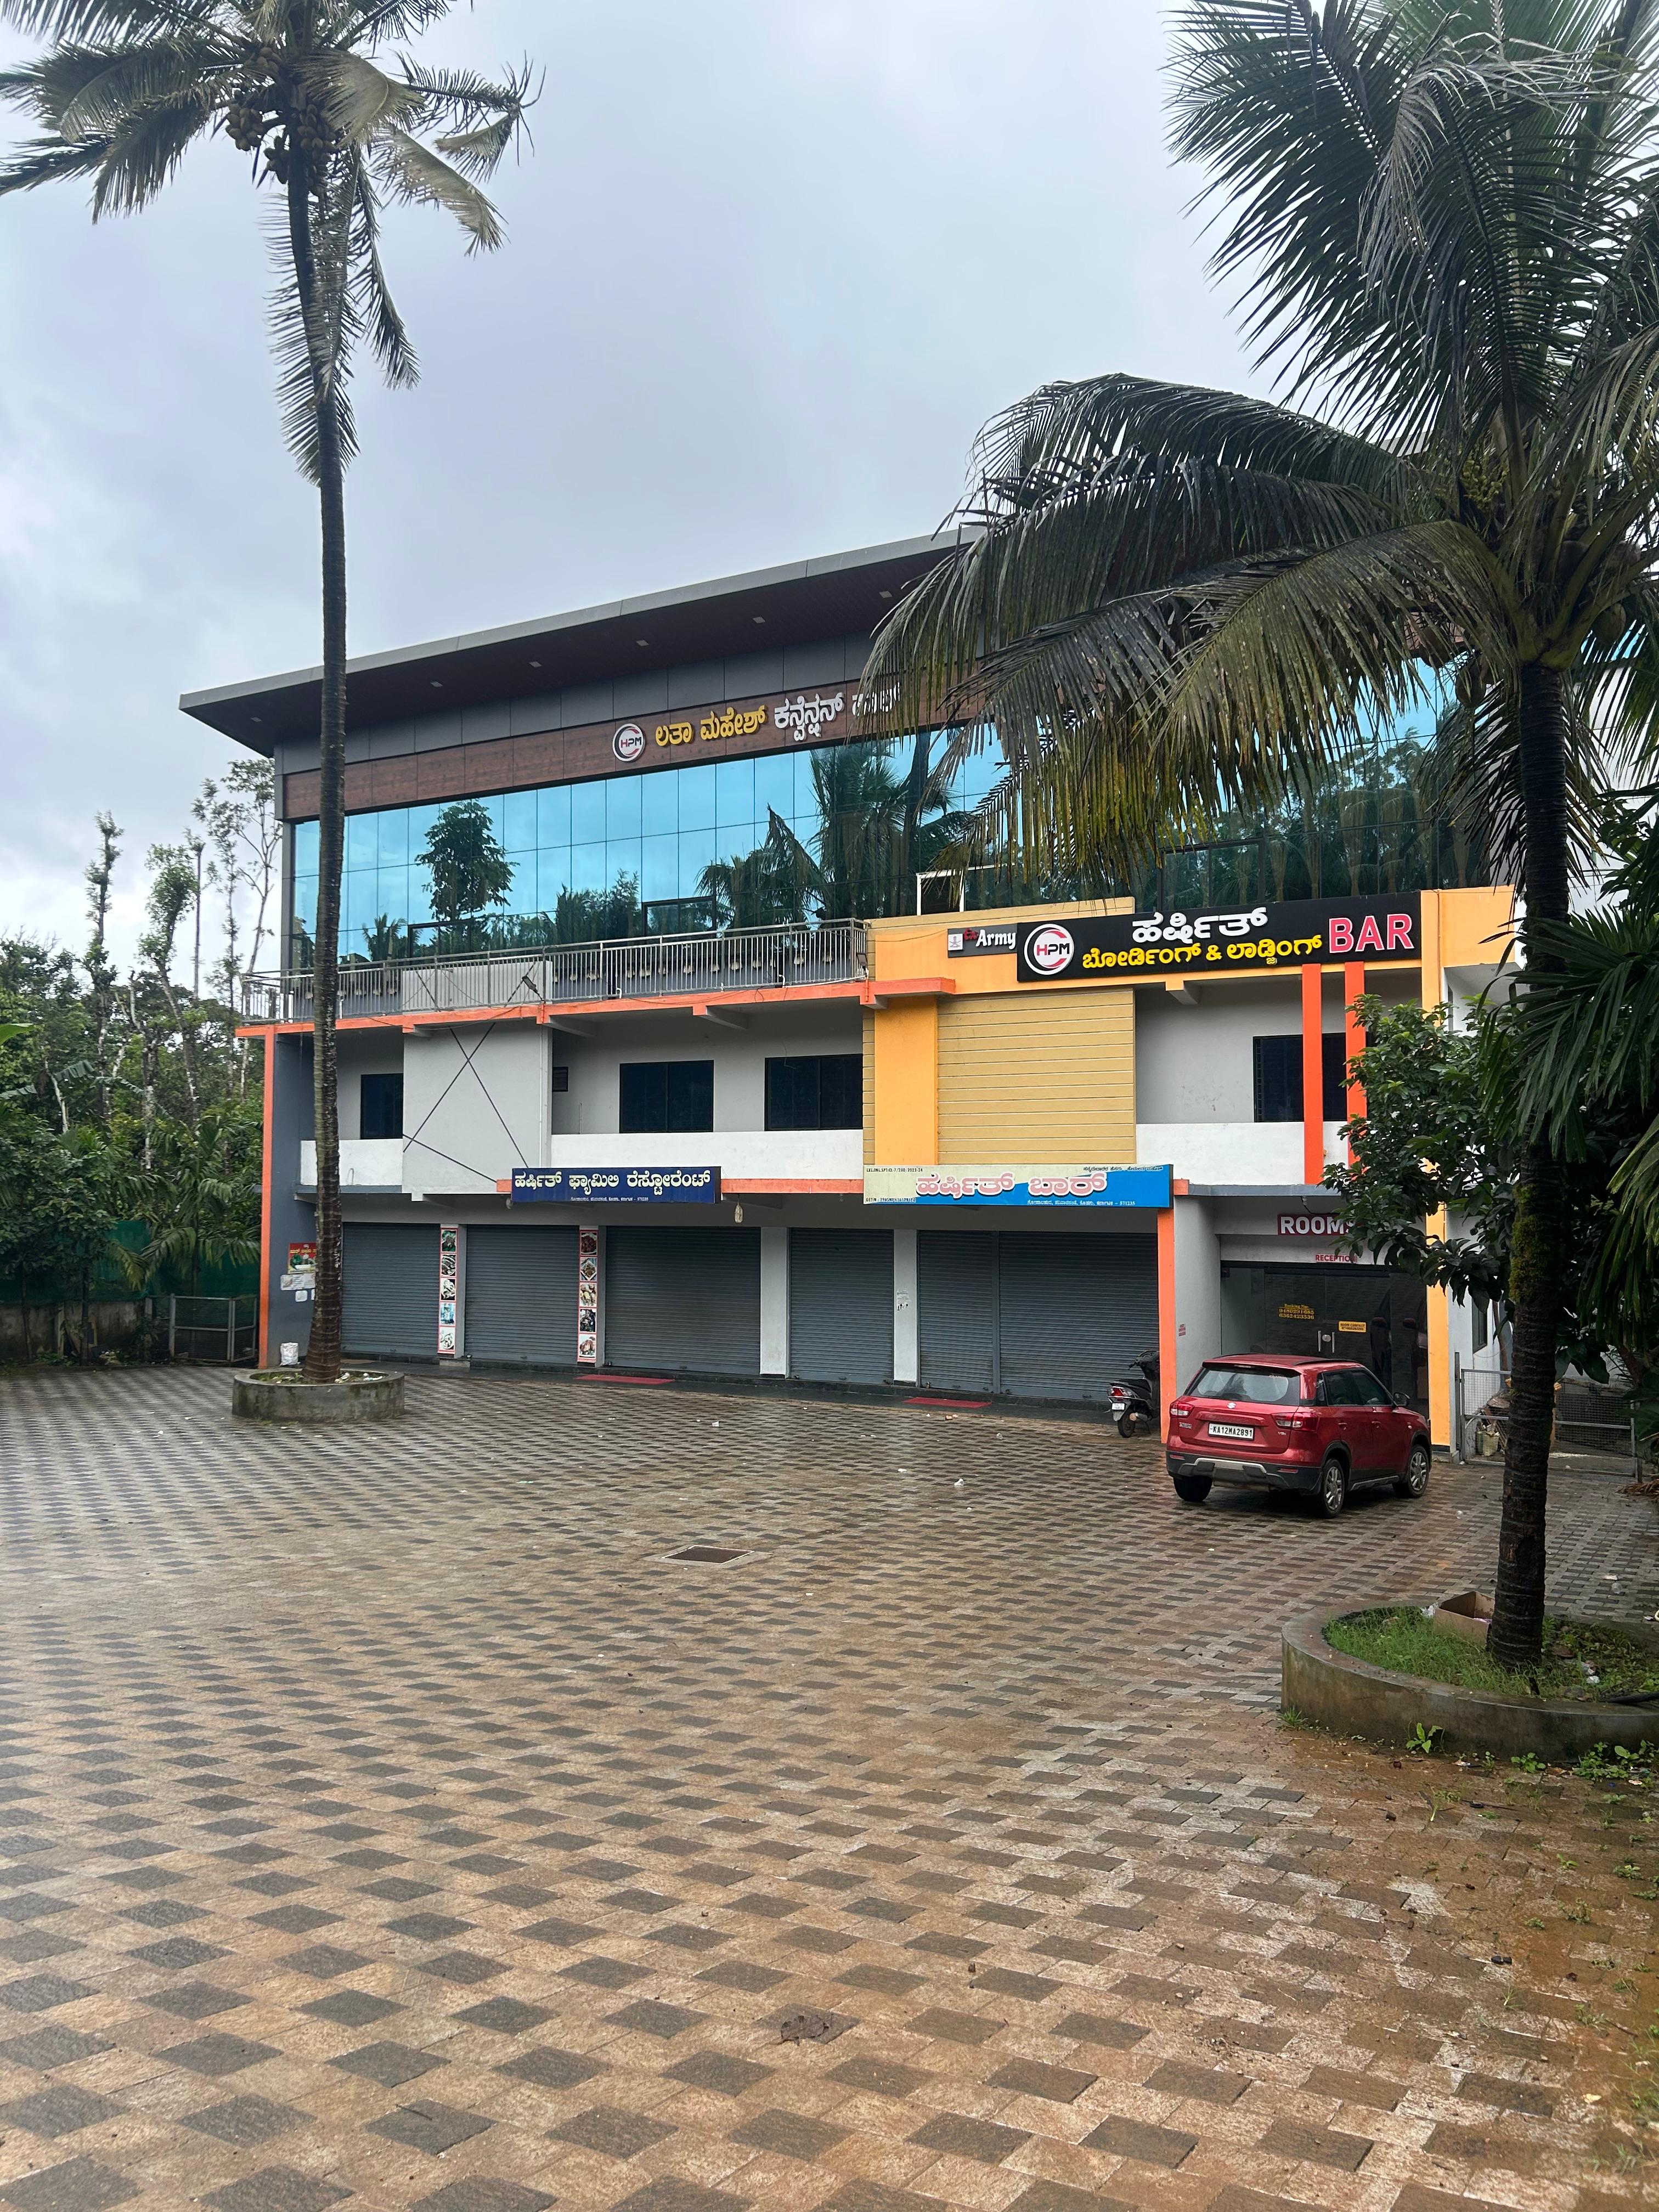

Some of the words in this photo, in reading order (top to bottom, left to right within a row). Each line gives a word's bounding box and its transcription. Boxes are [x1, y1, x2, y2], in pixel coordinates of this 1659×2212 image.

[656, 721, 693, 747] ಲತಾ
[700, 704, 768, 740] ಮಹೇಶ್
[620, 736, 641, 748] HPM
[1132, 907, 1268, 944] ಹರ್ಷಿತ್
[1329, 913, 1415, 953] BAR
[975, 929, 1016, 950] Army
[1036, 943, 1070, 956] HPM
[1082, 943, 1201, 969] ಬೋರ್ಡಿಂಗ್
[1206, 945, 1222, 961] &
[515, 1171, 563, 1190] ಹರ್ಷಿತ್
[569, 1172, 619, 1195] ಫ್ಯಾಮಿಲಿ
[627, 1170, 711, 1195] ರೆಸ್ಟೋರೆಂಟ್
[916, 1173, 1015, 1199] ಹರ್ಷಿತ್
[1028, 1172, 1107, 1197] ಬಾರ್
[1213, 1426, 1252, 1437] KA12MA2891
